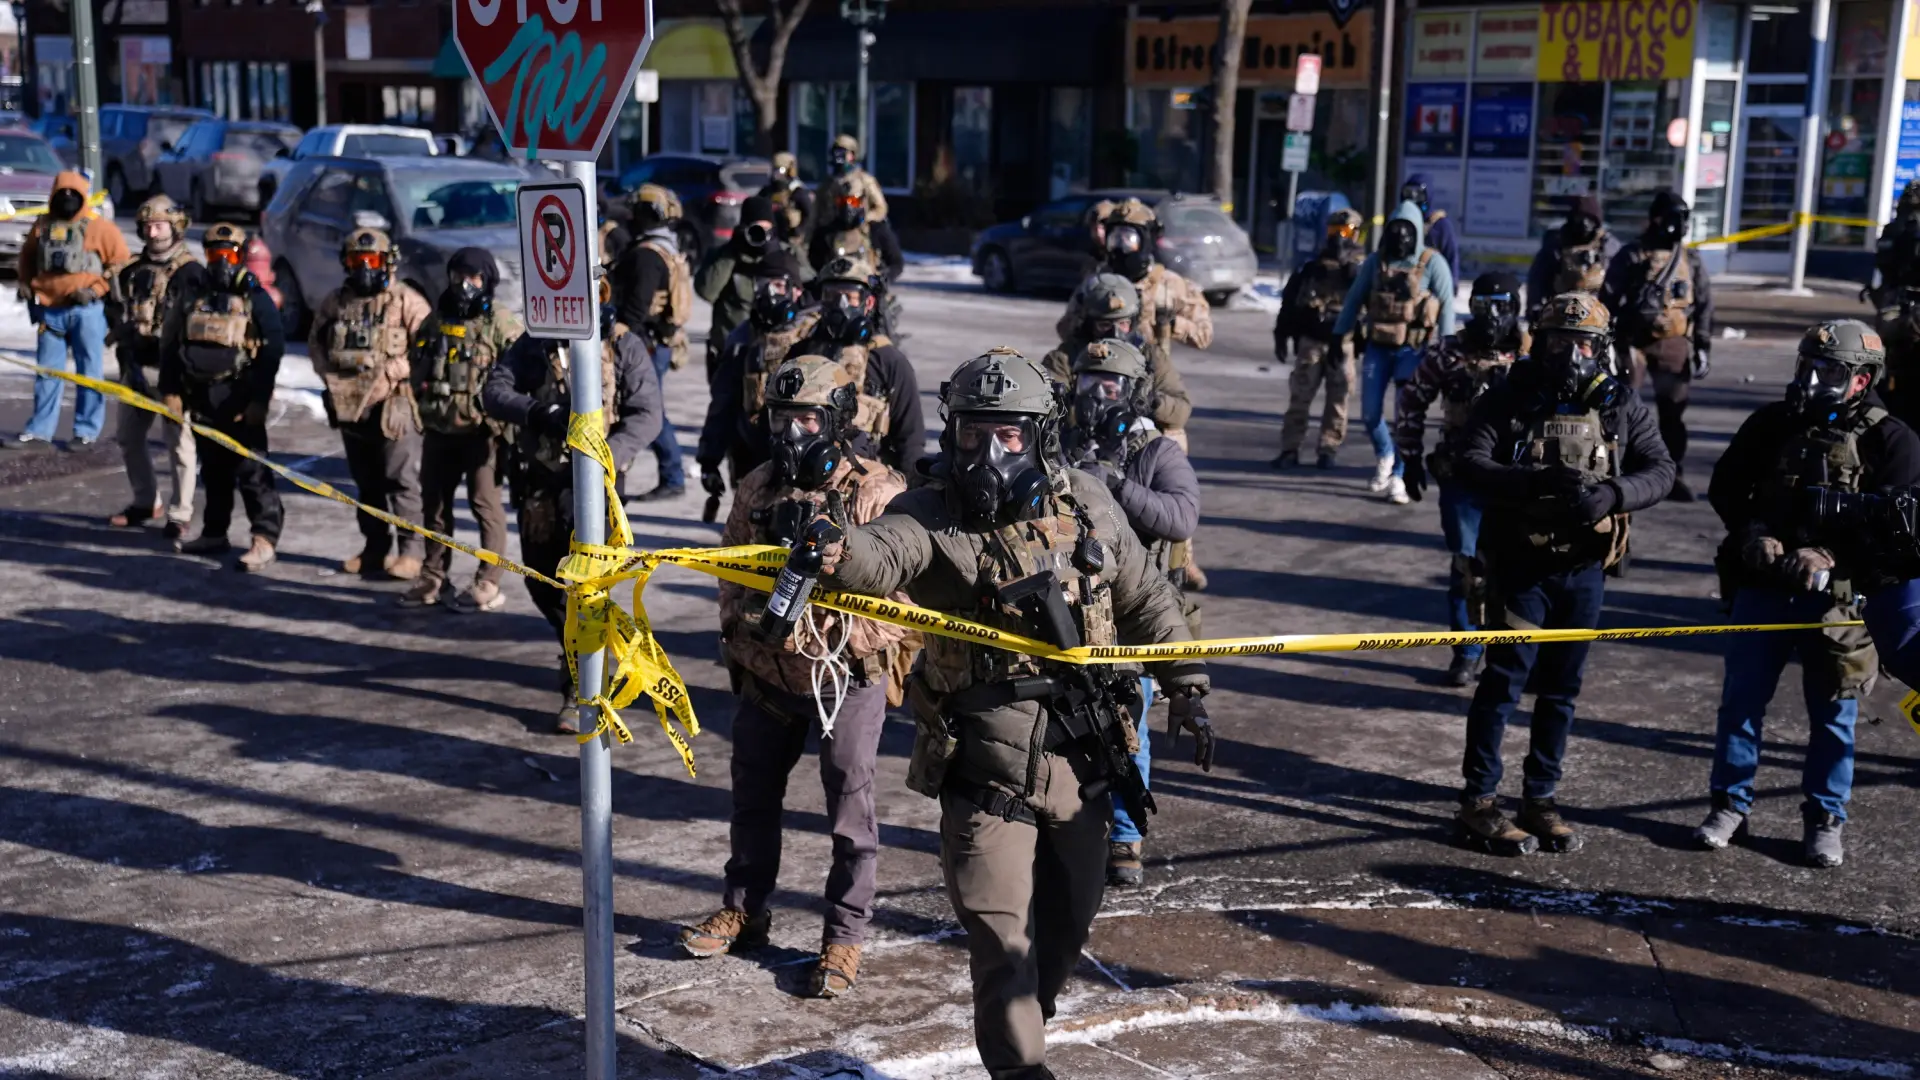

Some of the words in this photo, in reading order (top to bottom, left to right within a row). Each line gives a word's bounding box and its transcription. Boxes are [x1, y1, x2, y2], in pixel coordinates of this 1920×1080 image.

[1542, 0, 1693, 41] TOBACCO
[1563, 43, 1582, 81] &
[1598, 40, 1666, 80] MAS
[531, 295, 547, 324] 30
[553, 296, 585, 325] FEET
[1547, 423, 1589, 436] POLIC
[834, 592, 873, 613] LINE
[876, 604, 900, 619] DO
[903, 610, 941, 627] NOT
